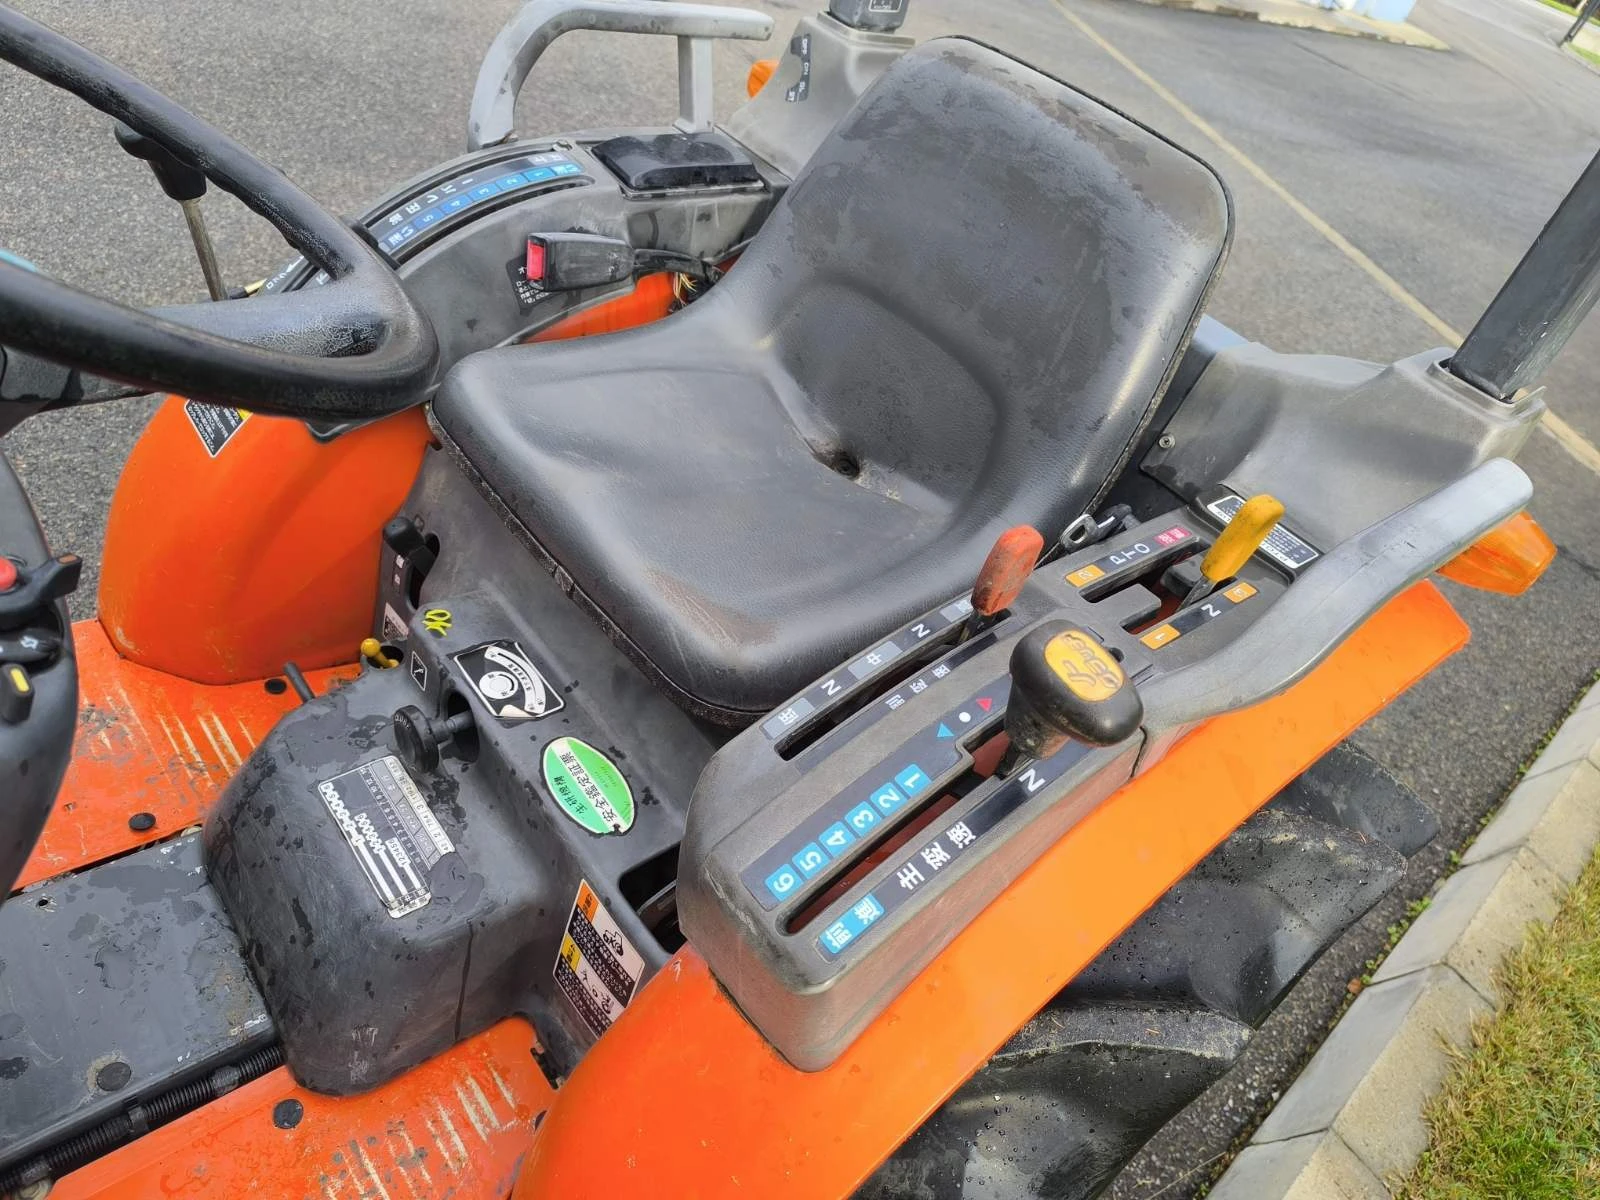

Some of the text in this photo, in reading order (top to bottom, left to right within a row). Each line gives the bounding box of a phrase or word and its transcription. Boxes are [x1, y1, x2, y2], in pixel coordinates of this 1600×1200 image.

[1109, 543, 1150, 565] PTO
[1201, 603, 1222, 617] N
[911, 623, 931, 638] N
[1155, 632, 1168, 641] 1
[866, 652, 882, 666] 中
[820, 679, 842, 696] N
[885, 663, 951, 710] 副変速
[778, 707, 799, 726] 低
[559, 749, 617, 824] 安全鑑定証票
[903, 772, 921, 788] 1
[1018, 768, 1046, 792] N
[878, 788, 901, 808] 2
[852, 809, 875, 828] 3
[825, 831, 849, 848] 4
[799, 851, 822, 872] 5
[896, 821, 977, 891] 主変速
[772, 872, 795, 893] 6
[825, 897, 882, 949] 前進
